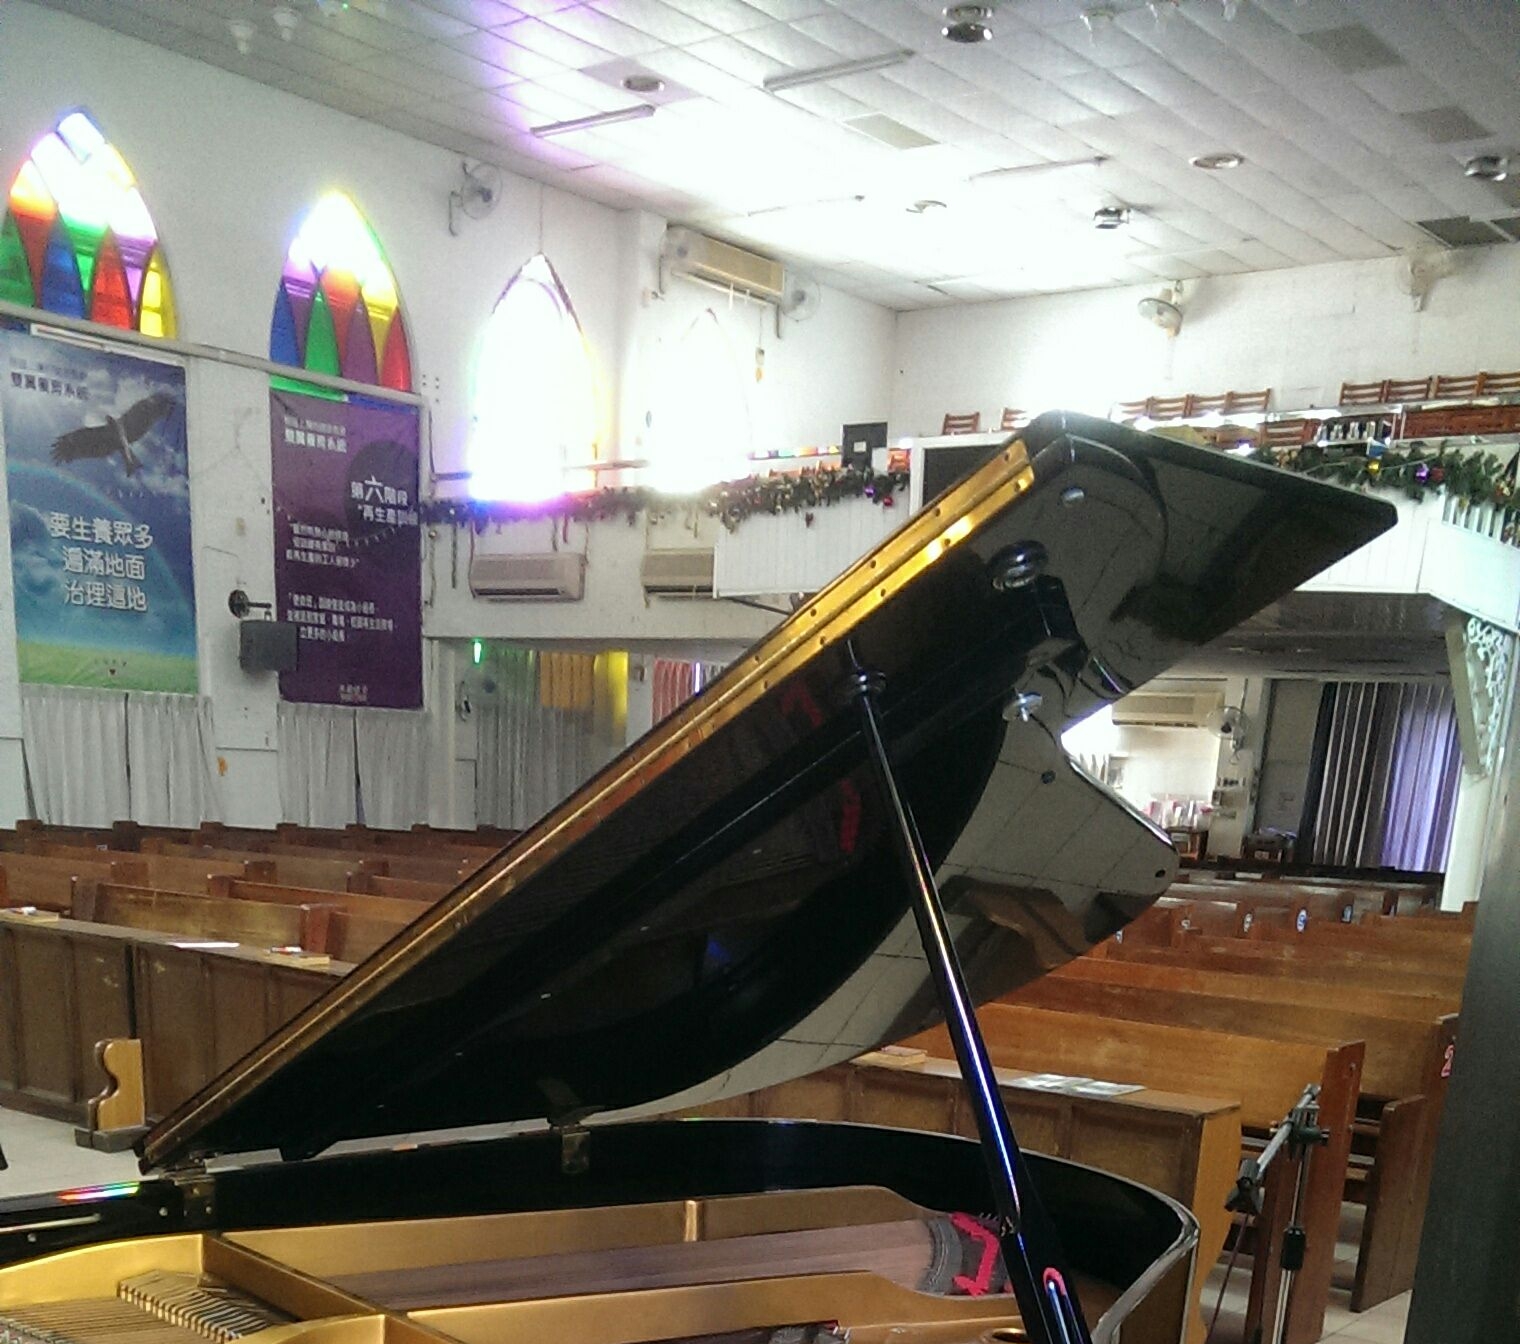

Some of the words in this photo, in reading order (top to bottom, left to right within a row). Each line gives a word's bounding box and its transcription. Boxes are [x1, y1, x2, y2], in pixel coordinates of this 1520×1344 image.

[50, 511, 154, 549] 要生養眾多
[64, 580, 147, 612] 治理這地
